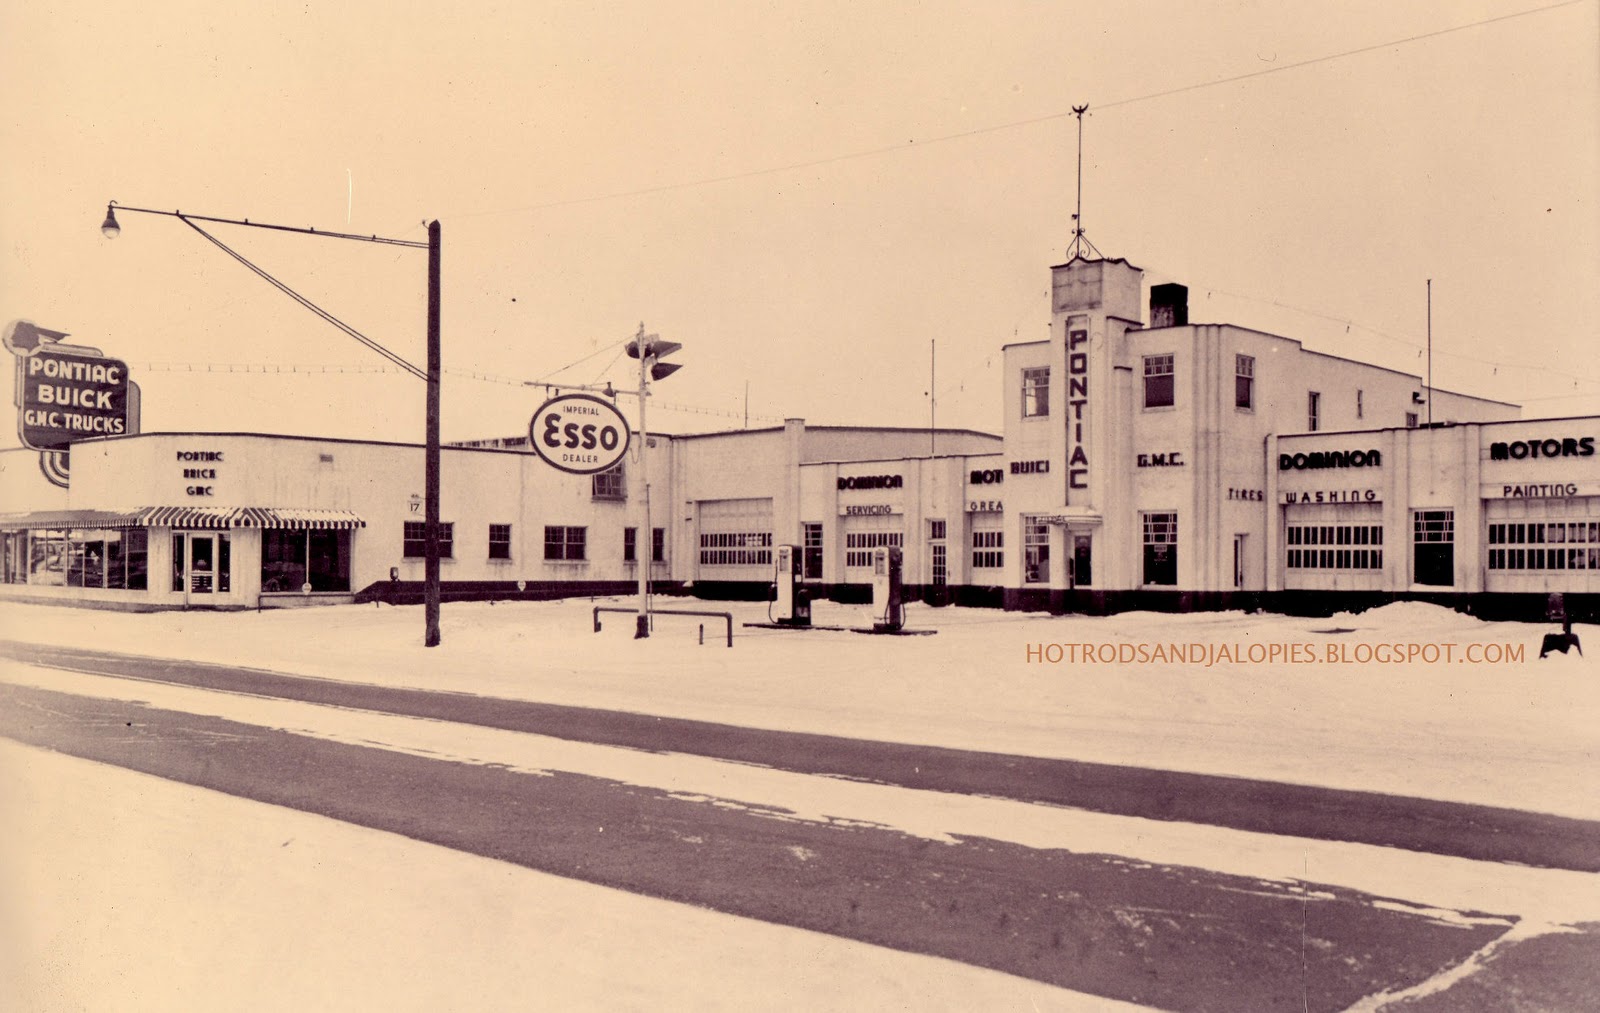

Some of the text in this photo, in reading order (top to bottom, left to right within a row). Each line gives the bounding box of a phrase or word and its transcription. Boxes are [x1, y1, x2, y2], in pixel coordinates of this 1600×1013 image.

[29, 357, 120, 385] PONTIAC
[38, 384, 113, 410] BUICK
[563, 405, 600, 416] IMPERIAL
[1069, 329, 1088, 489] PONTIAC
[64, 413, 124, 434] TRUCKS
[1491, 437, 1595, 460] MOTORS
[563, 453, 598, 463] DEALER
[1280, 450, 1381, 471] DOMINION
[970, 469, 1004, 485] MOT
[1228, 488, 1263, 501] TIRES
[1286, 490, 1375, 503] WASHING
[1503, 483, 1577, 497] PAINTING
[410, 503, 420, 511] 17
[846, 504, 891, 515] SERVICING
